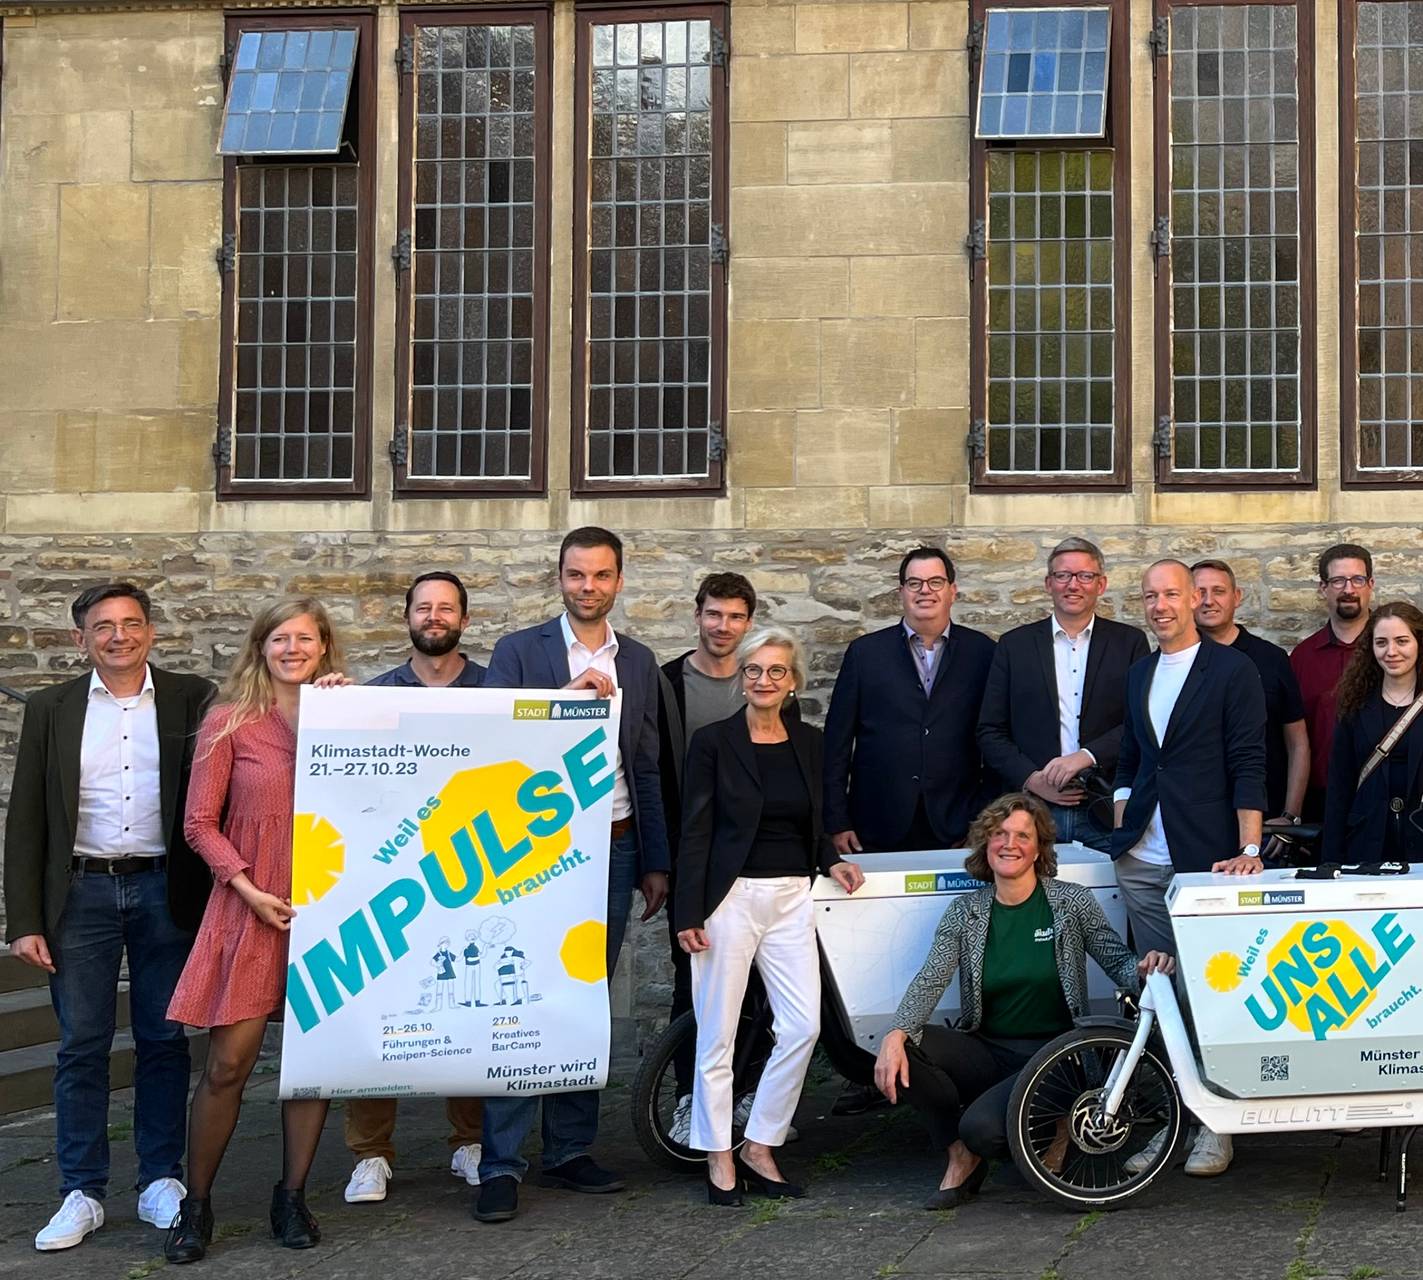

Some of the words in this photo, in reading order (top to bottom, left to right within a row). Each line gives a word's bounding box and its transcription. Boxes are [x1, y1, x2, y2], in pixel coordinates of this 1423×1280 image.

[517, 708, 547, 718] STADT
[562, 705, 607, 718] MÜNSTER
[311, 744, 471, 758] Klimastadt-Woche
[372, 817, 419, 866] Weil
[416, 795, 442, 822] es
[286, 726, 616, 1035] IMPULSE
[495, 848, 592, 906] braucht.
[908, 881, 933, 890] STADT
[1240, 896, 1261, 905] STADT
[1271, 894, 1303, 904] MÜNSTER
[1236, 943, 1262, 978] Weil
[1256, 927, 1269, 946] es
[1244, 921, 1342, 1031] UNS
[1305, 913, 1416, 1041] ALLE
[1366, 985, 1423, 1029] braucht.
[492, 1016, 521, 1026] 27.10.
[382, 1037, 442, 1050] Führungen
[443, 1035, 452, 1044] &
[492, 1029, 541, 1040] Kreatives
[382, 1046, 473, 1062] Kneipen-Science
[492, 1040, 542, 1053] BarCamp
[1360, 1049, 1421, 1063] Münster
[486, 1063, 556, 1080] Münster
[560, 1058, 597, 1073] wird
[506, 1075, 599, 1091] Klimastadt.
[330, 1088, 355, 1096] Hier
[1240, 1105, 1345, 1125] BULLITT
